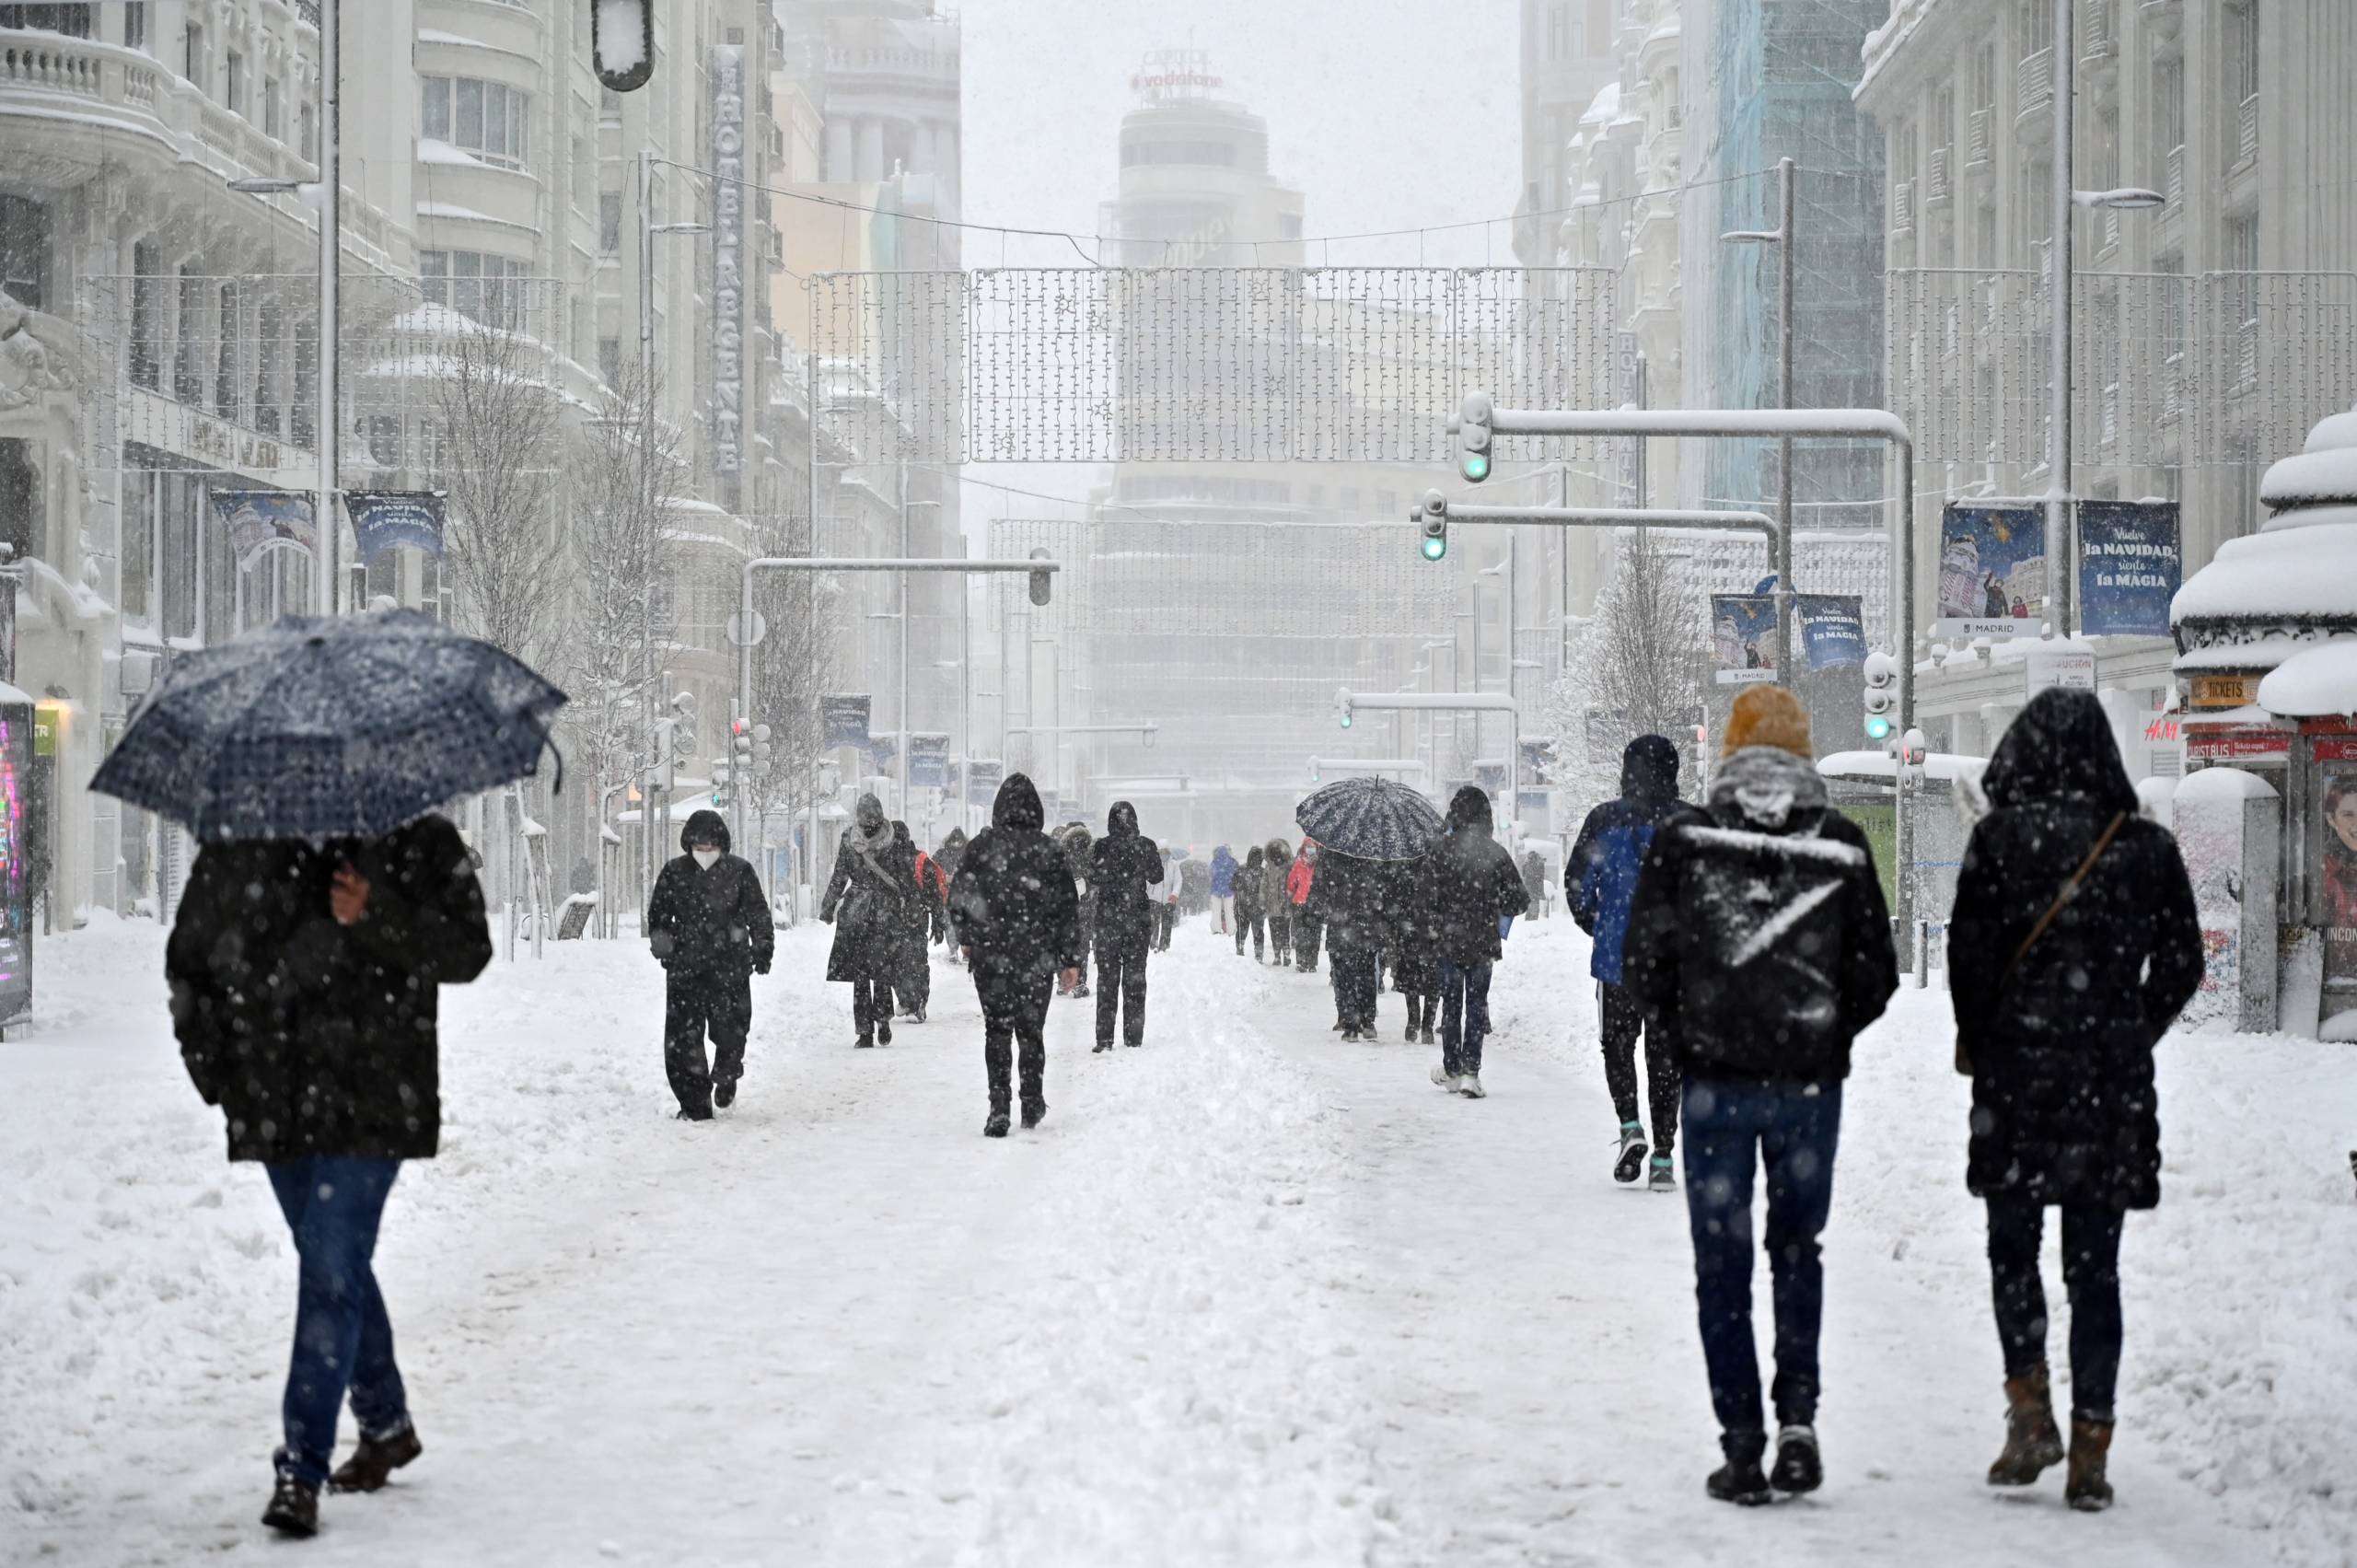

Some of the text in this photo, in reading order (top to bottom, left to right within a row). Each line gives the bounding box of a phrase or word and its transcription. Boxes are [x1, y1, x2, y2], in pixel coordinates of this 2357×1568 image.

[1144, 69, 1224, 87] vodafone
[385, 517, 434, 531] MAGIA
[2114, 528, 2146, 540] Vuelve
[2084, 542, 2174, 557] la NAVIDAD
[2119, 559, 2146, 571] siente
[2096, 574, 2167, 587] la MAGIA
[1976, 625, 2014, 633] MADRID
[1826, 631, 1859, 641] MAGIA
[2209, 680, 2244, 698] TICKETS
[2144, 718, 2178, 741] H&M
[2211, 744, 2230, 757] BUS
